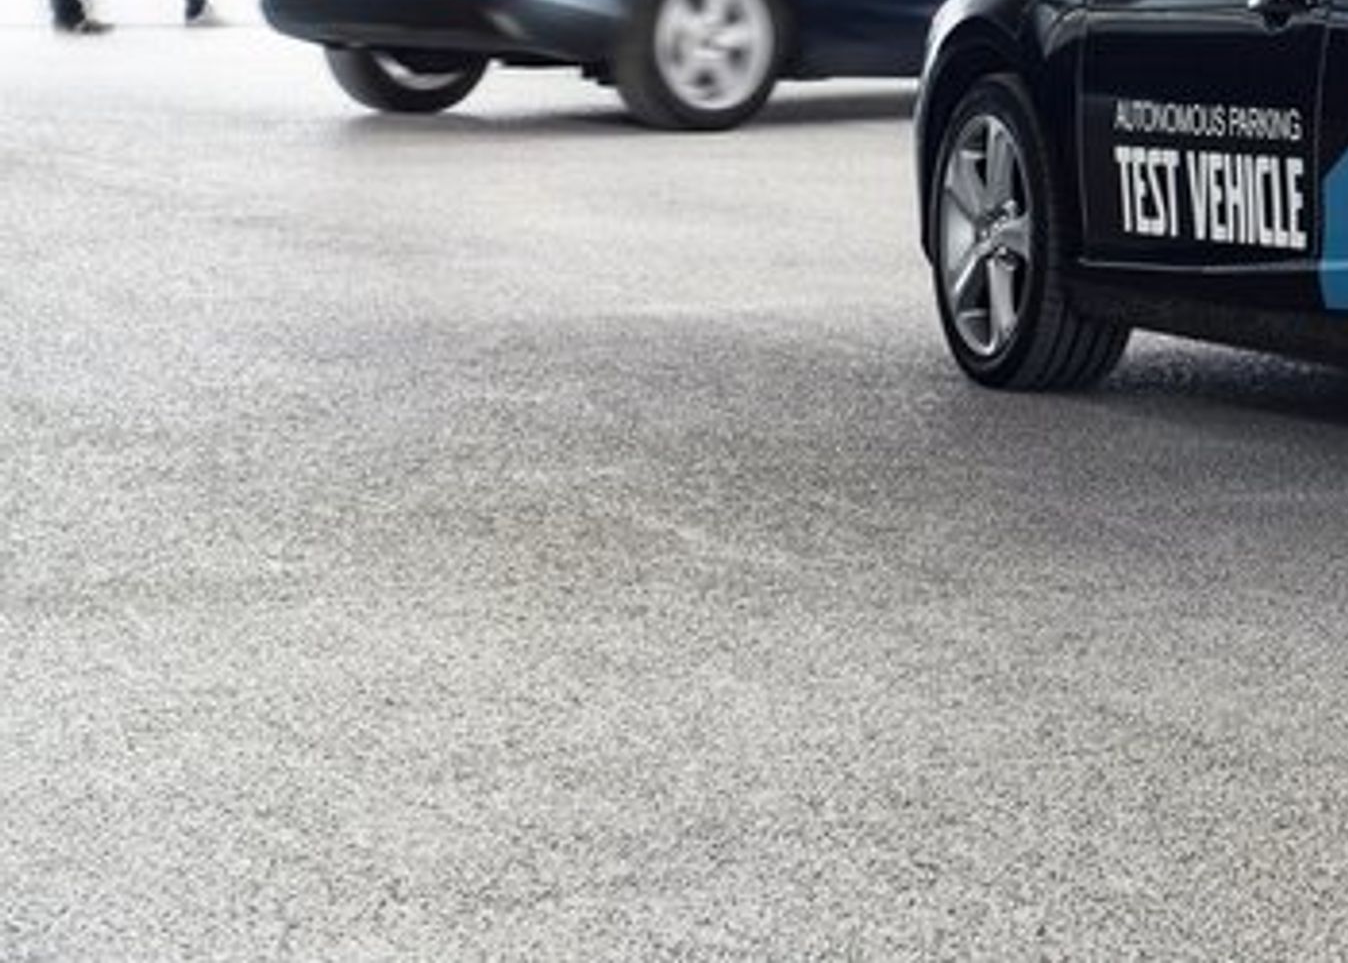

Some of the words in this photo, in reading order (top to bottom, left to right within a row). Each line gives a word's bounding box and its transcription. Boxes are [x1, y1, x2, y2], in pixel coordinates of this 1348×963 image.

[1114, 99, 1226, 137] AUTONOMOUS
[1228, 106, 1302, 141] PARKING
[1114, 145, 1180, 238] TEST
[1185, 149, 1307, 250] VEHICLE
